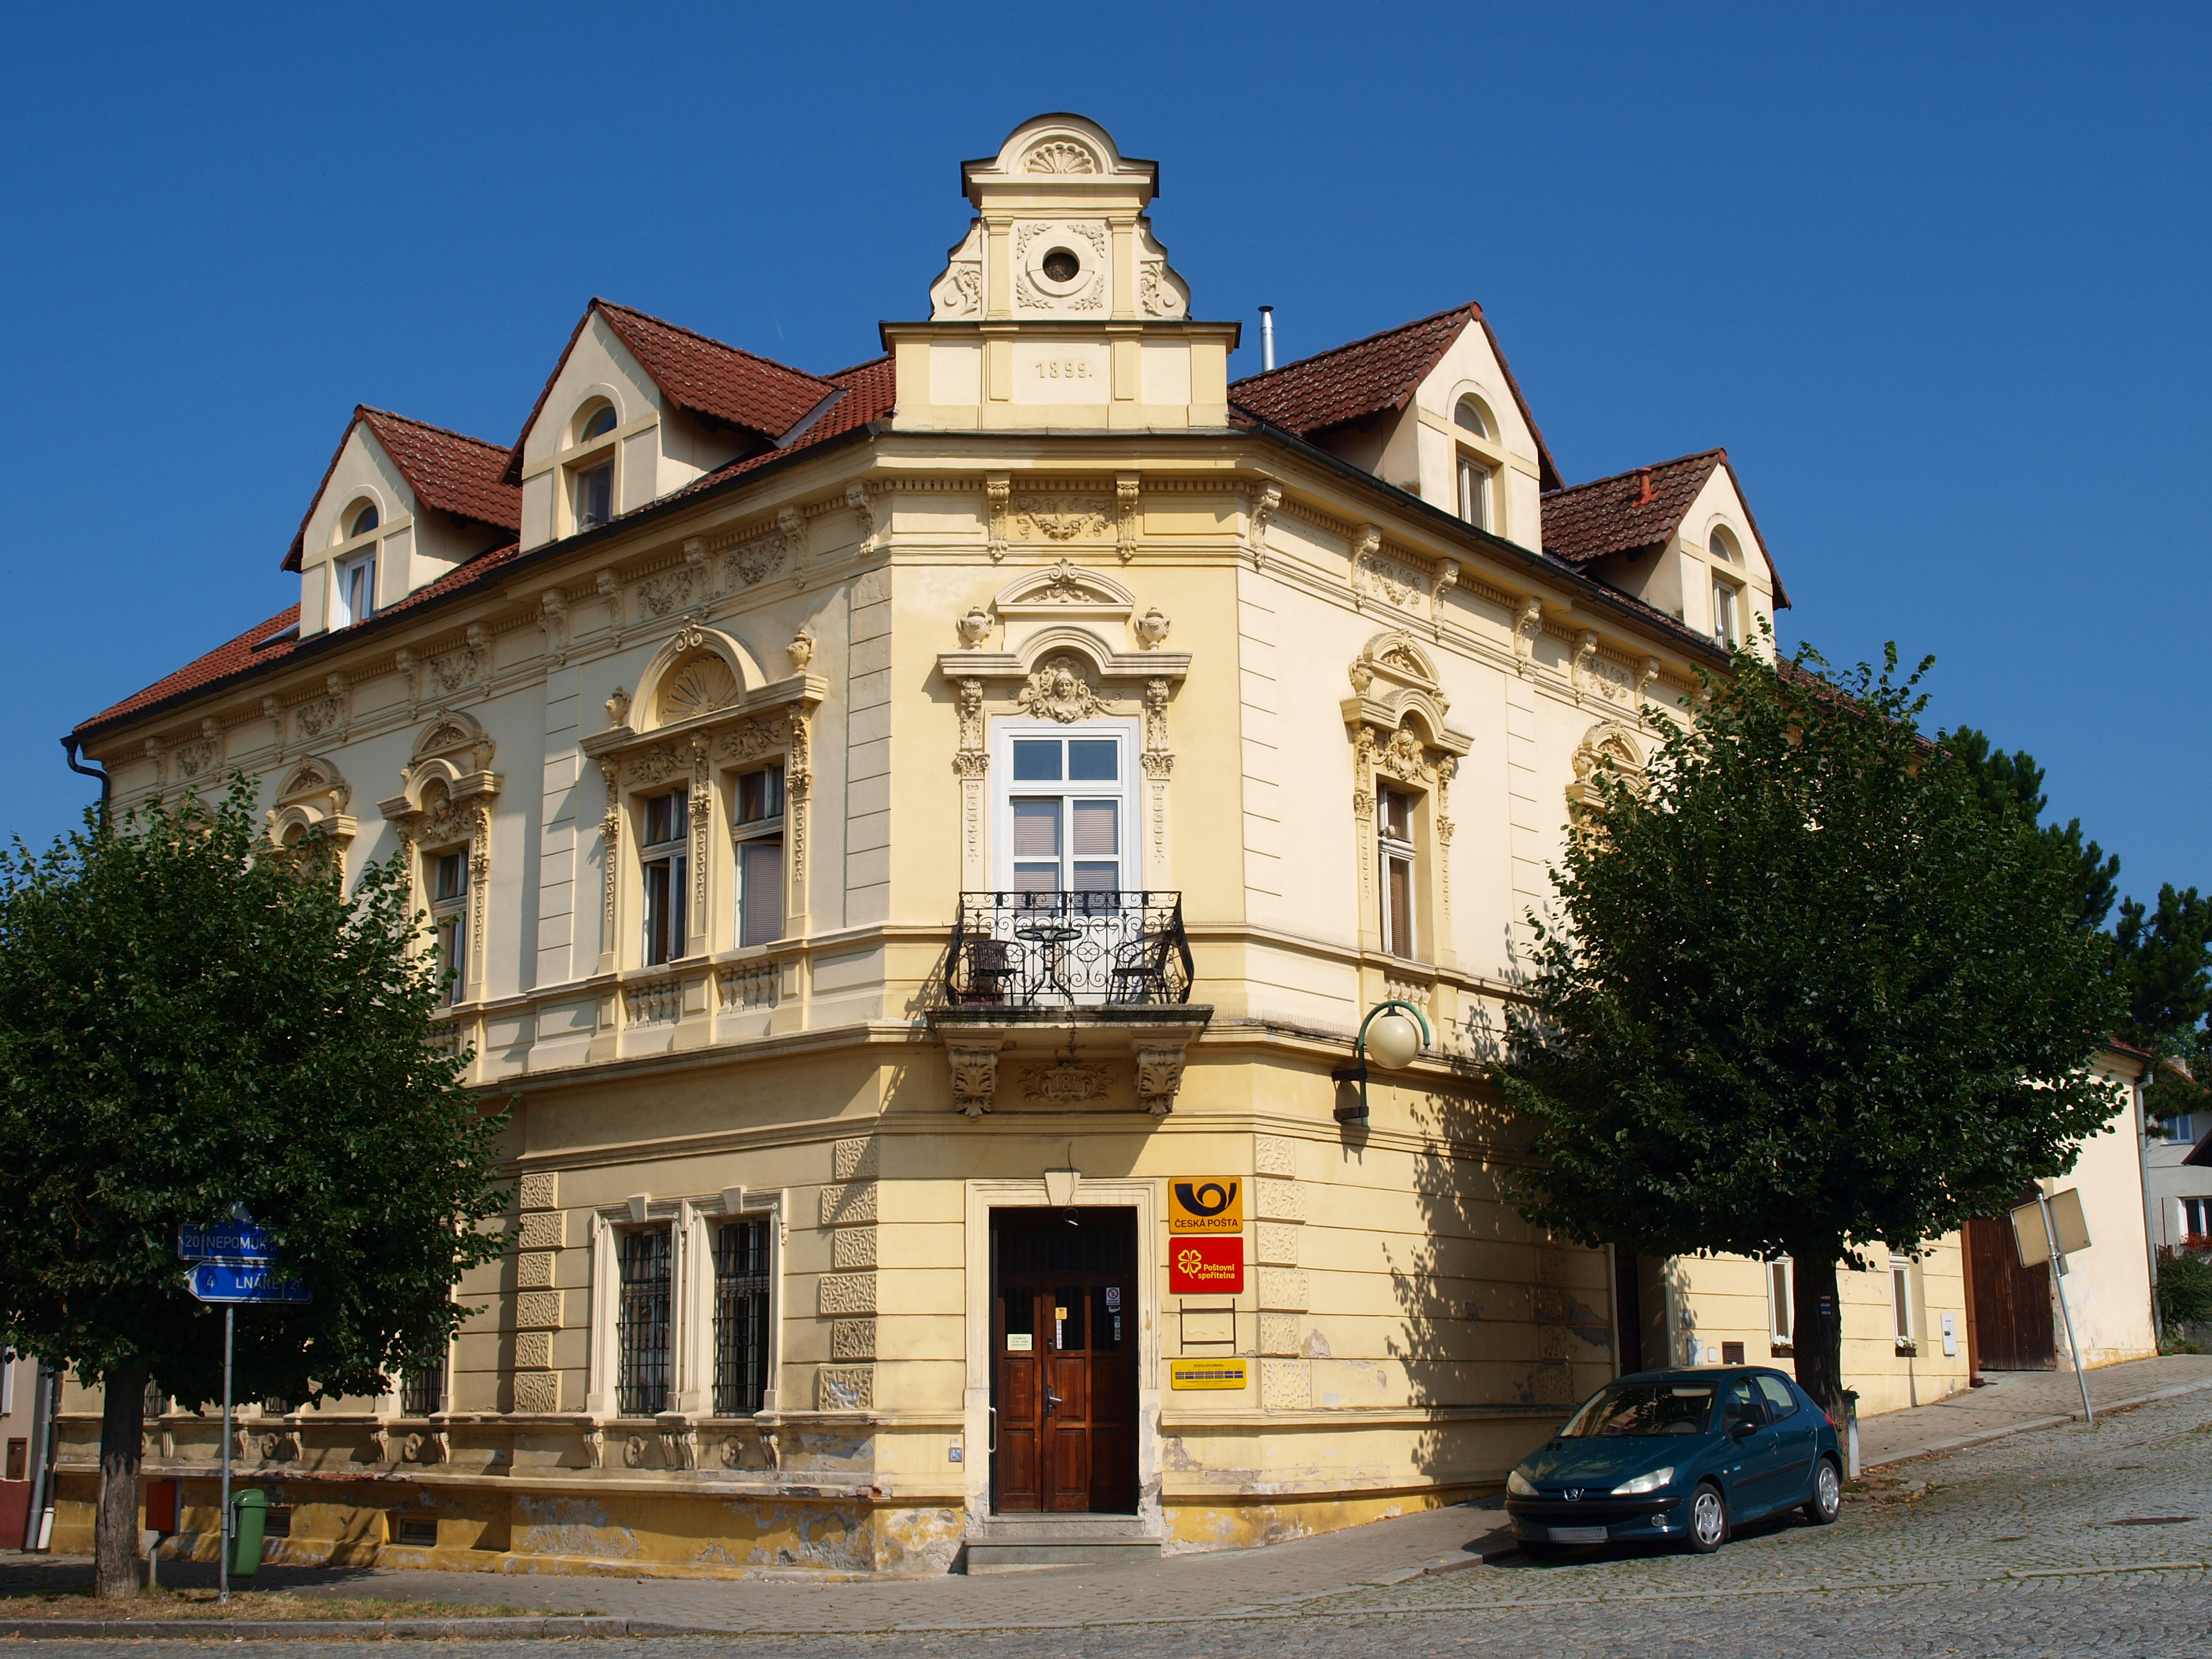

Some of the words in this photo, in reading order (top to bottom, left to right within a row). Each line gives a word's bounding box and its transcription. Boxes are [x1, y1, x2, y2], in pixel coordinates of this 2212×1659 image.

[1175, 1218, 1205, 1228] ČESKÁ
[1208, 1217, 1238, 1227] POŠTA
[185, 1235, 199, 1247] 20
[207, 1236, 267, 1250] NEPOMUK
[206, 1275, 214, 1288] 4
[1198, 1271, 1235, 1281] spořitelna
